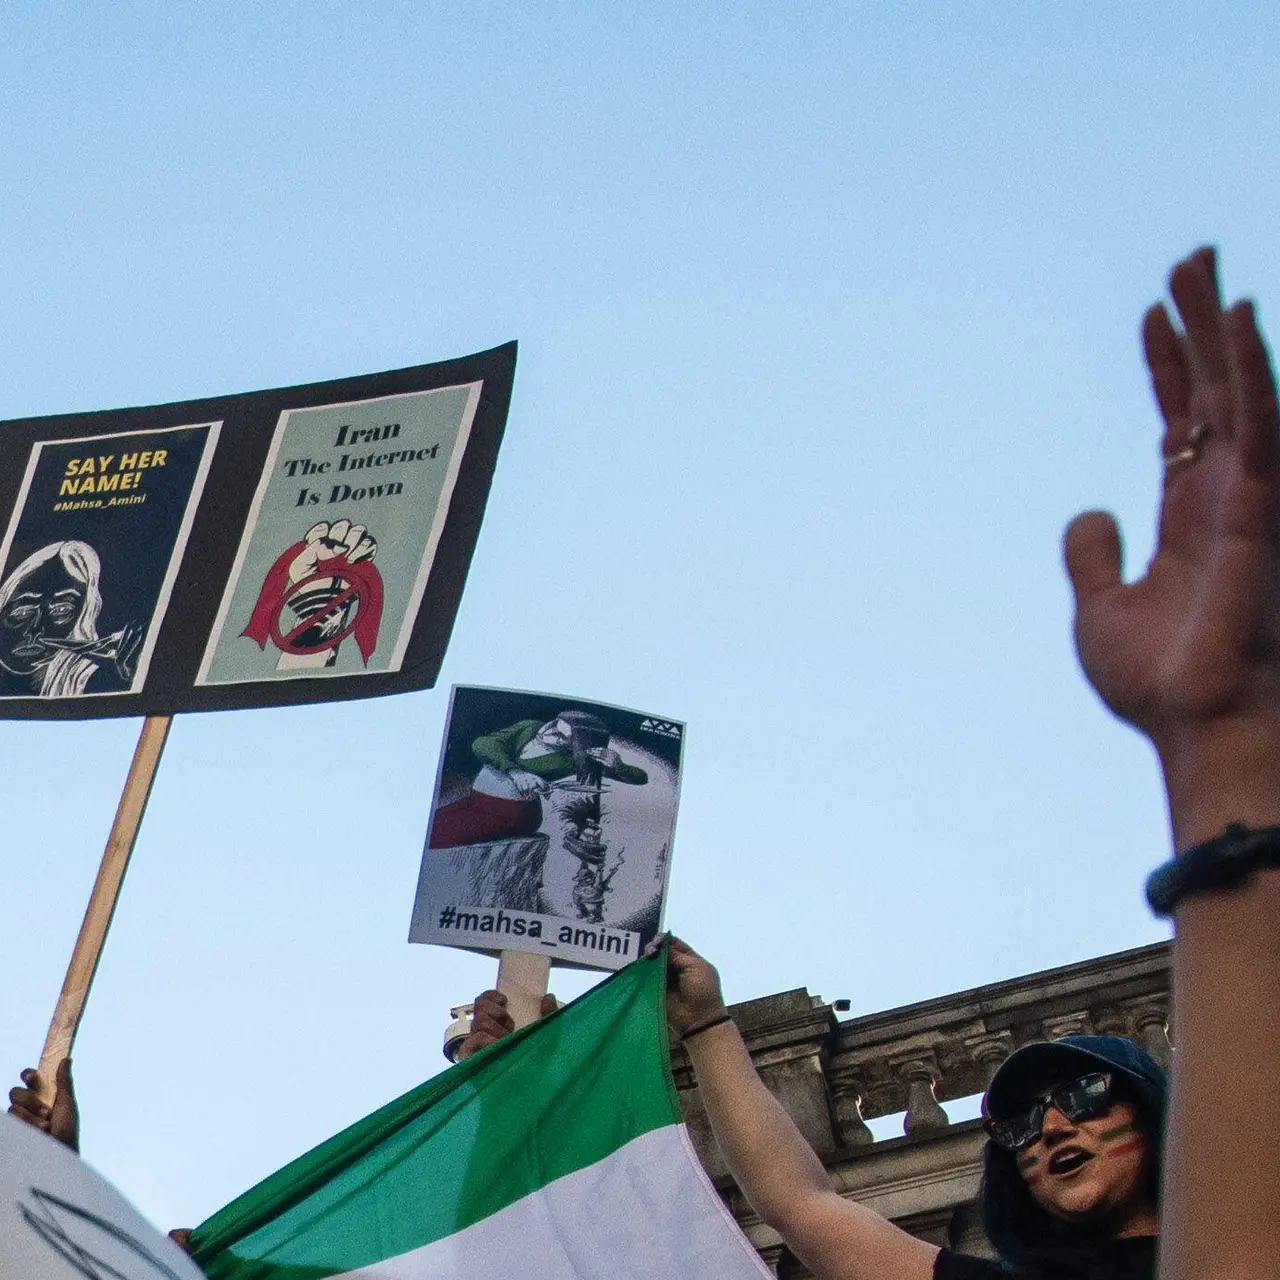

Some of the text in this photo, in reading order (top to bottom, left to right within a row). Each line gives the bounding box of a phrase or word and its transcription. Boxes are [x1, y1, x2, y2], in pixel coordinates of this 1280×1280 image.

[333, 423, 401, 447] Iran
[65, 450, 168, 476] SAY HER
[284, 442, 441, 478] The Internet
[59, 472, 142, 496] NAME!
[295, 482, 404, 507] Is Down
[53, 493, 147, 512] #Mahsa_Amini
[439, 905, 630, 955] #mahsa_amini
